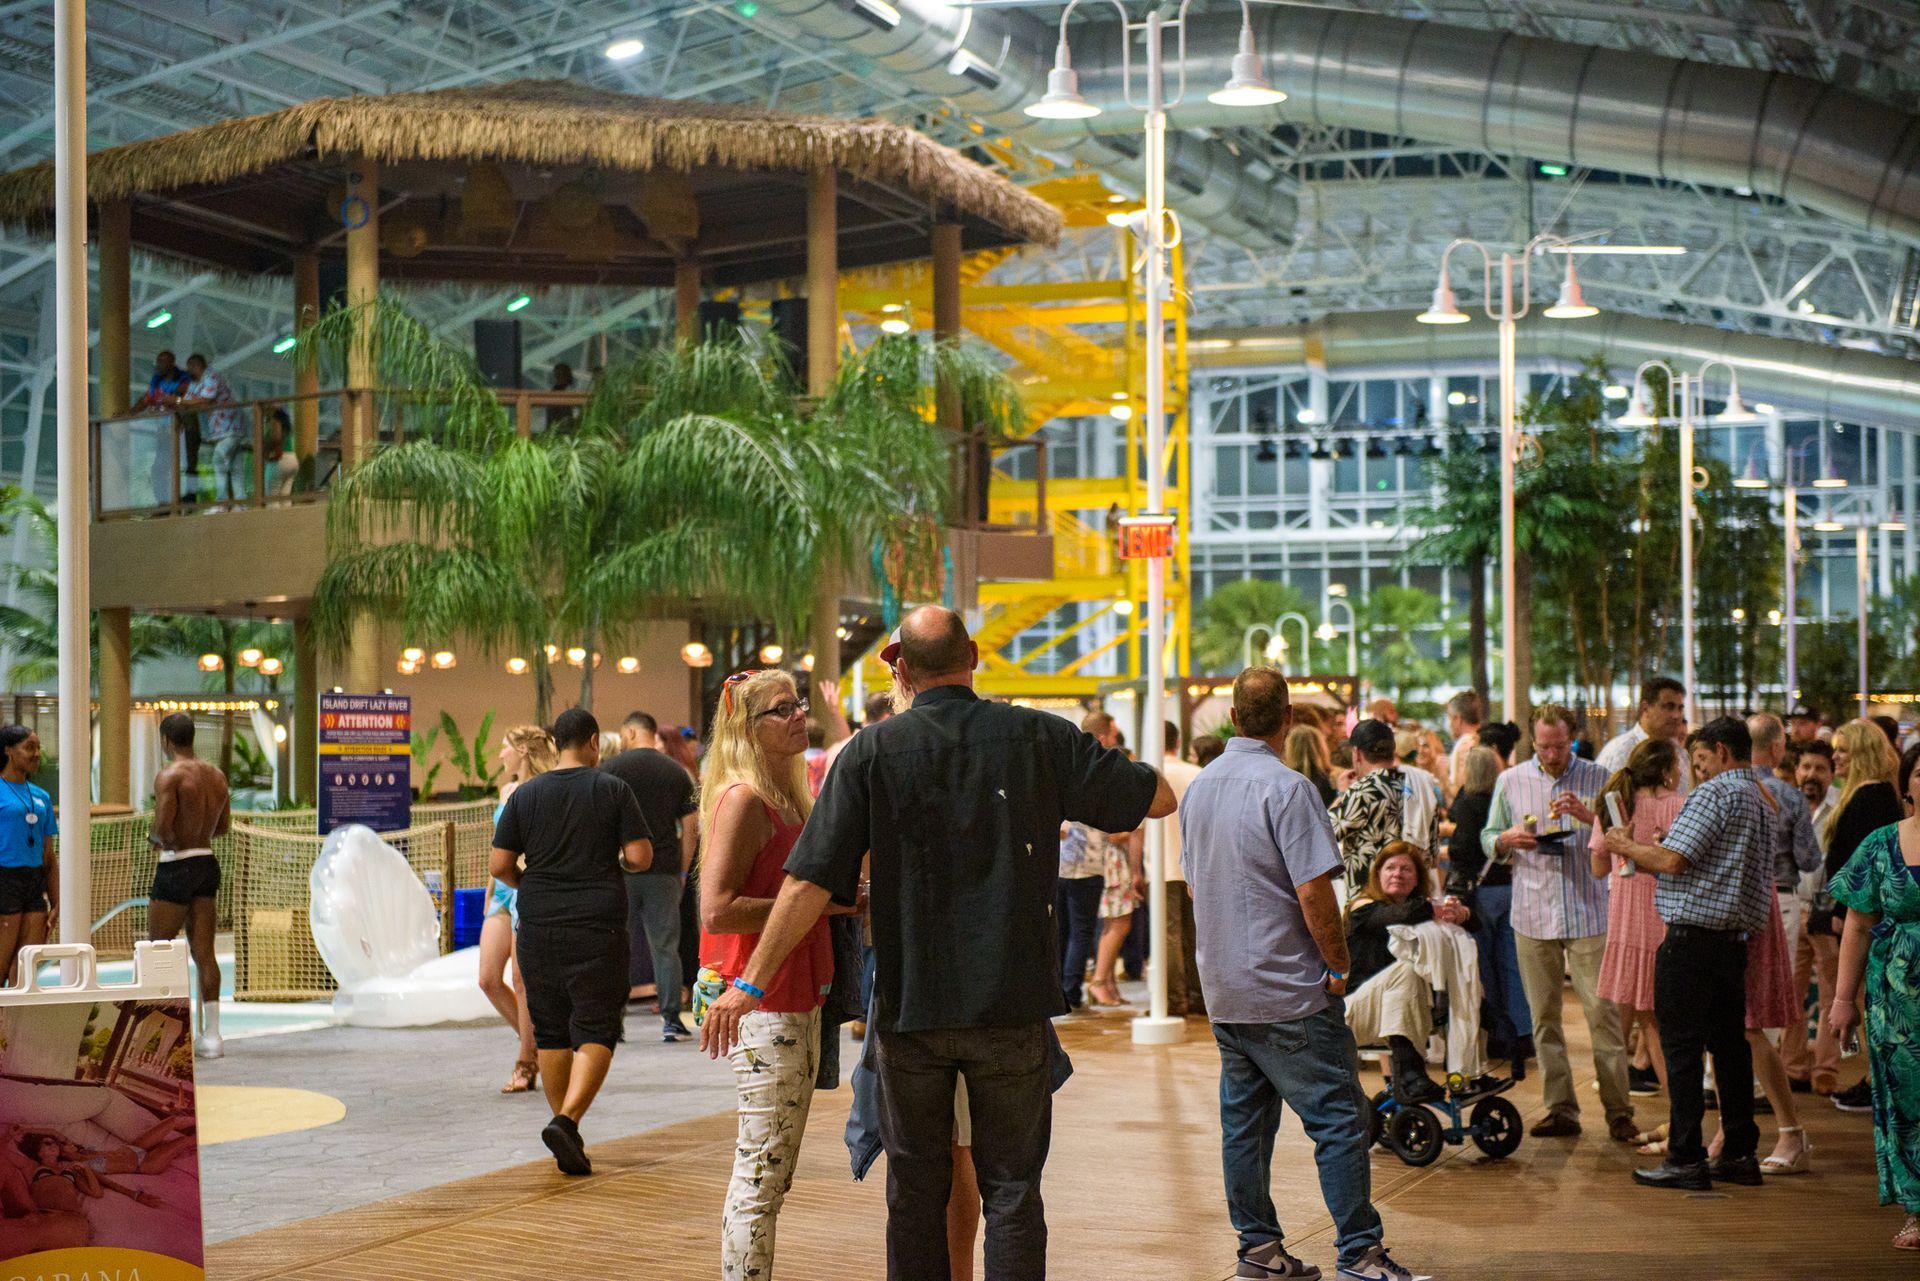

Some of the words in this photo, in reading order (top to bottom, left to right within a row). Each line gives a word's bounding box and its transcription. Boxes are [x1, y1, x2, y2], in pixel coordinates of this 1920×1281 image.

[1129, 526, 1168, 557] EXIT
[323, 698, 347, 710] ISLAND
[349, 698, 368, 710] DRIFT
[370, 699, 386, 711] LAZY
[388, 699, 407, 711] RIVER
[338, 714, 393, 729] ATTENTION
